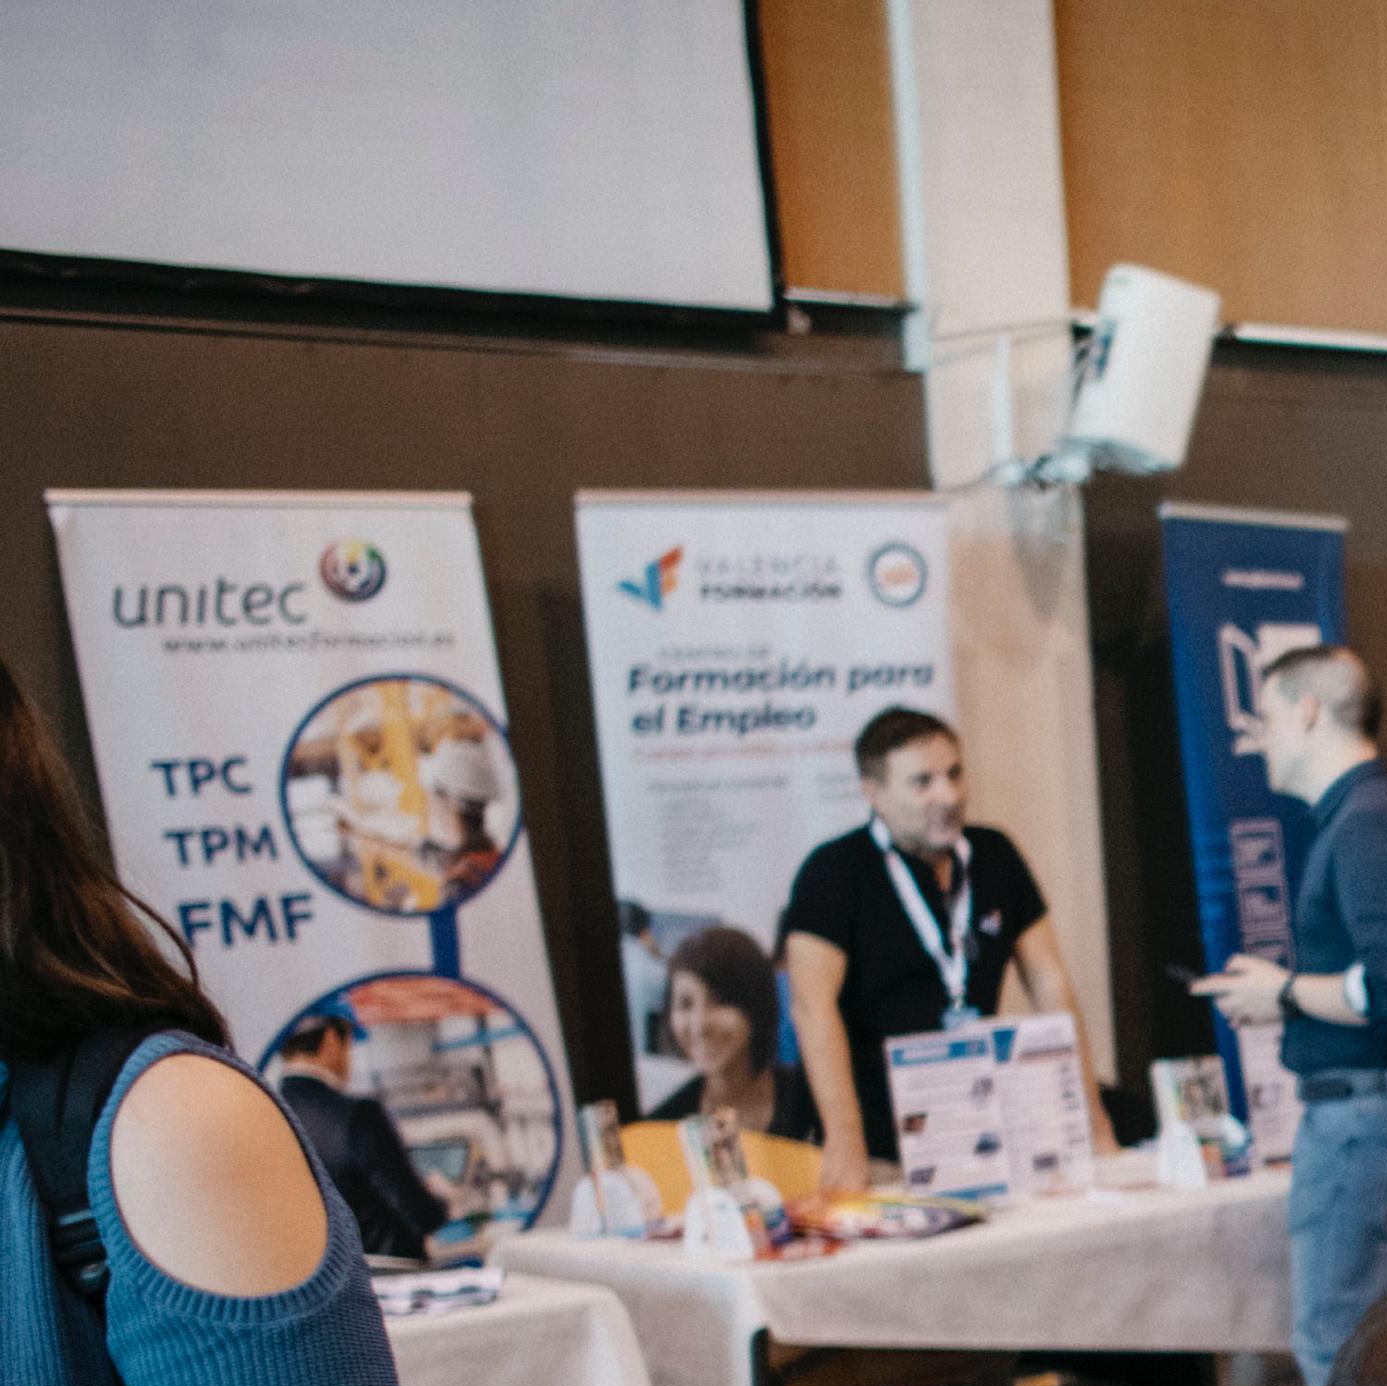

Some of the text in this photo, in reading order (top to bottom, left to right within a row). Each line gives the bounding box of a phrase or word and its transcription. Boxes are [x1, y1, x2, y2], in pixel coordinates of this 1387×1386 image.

[113, 576, 307, 628] unitec
[628, 658, 933, 695] Formación para
[631, 702, 815, 738] el Empleo
[152, 757, 252, 796] TPC
[164, 824, 278, 868] TPM
[178, 893, 312, 948] FMF
